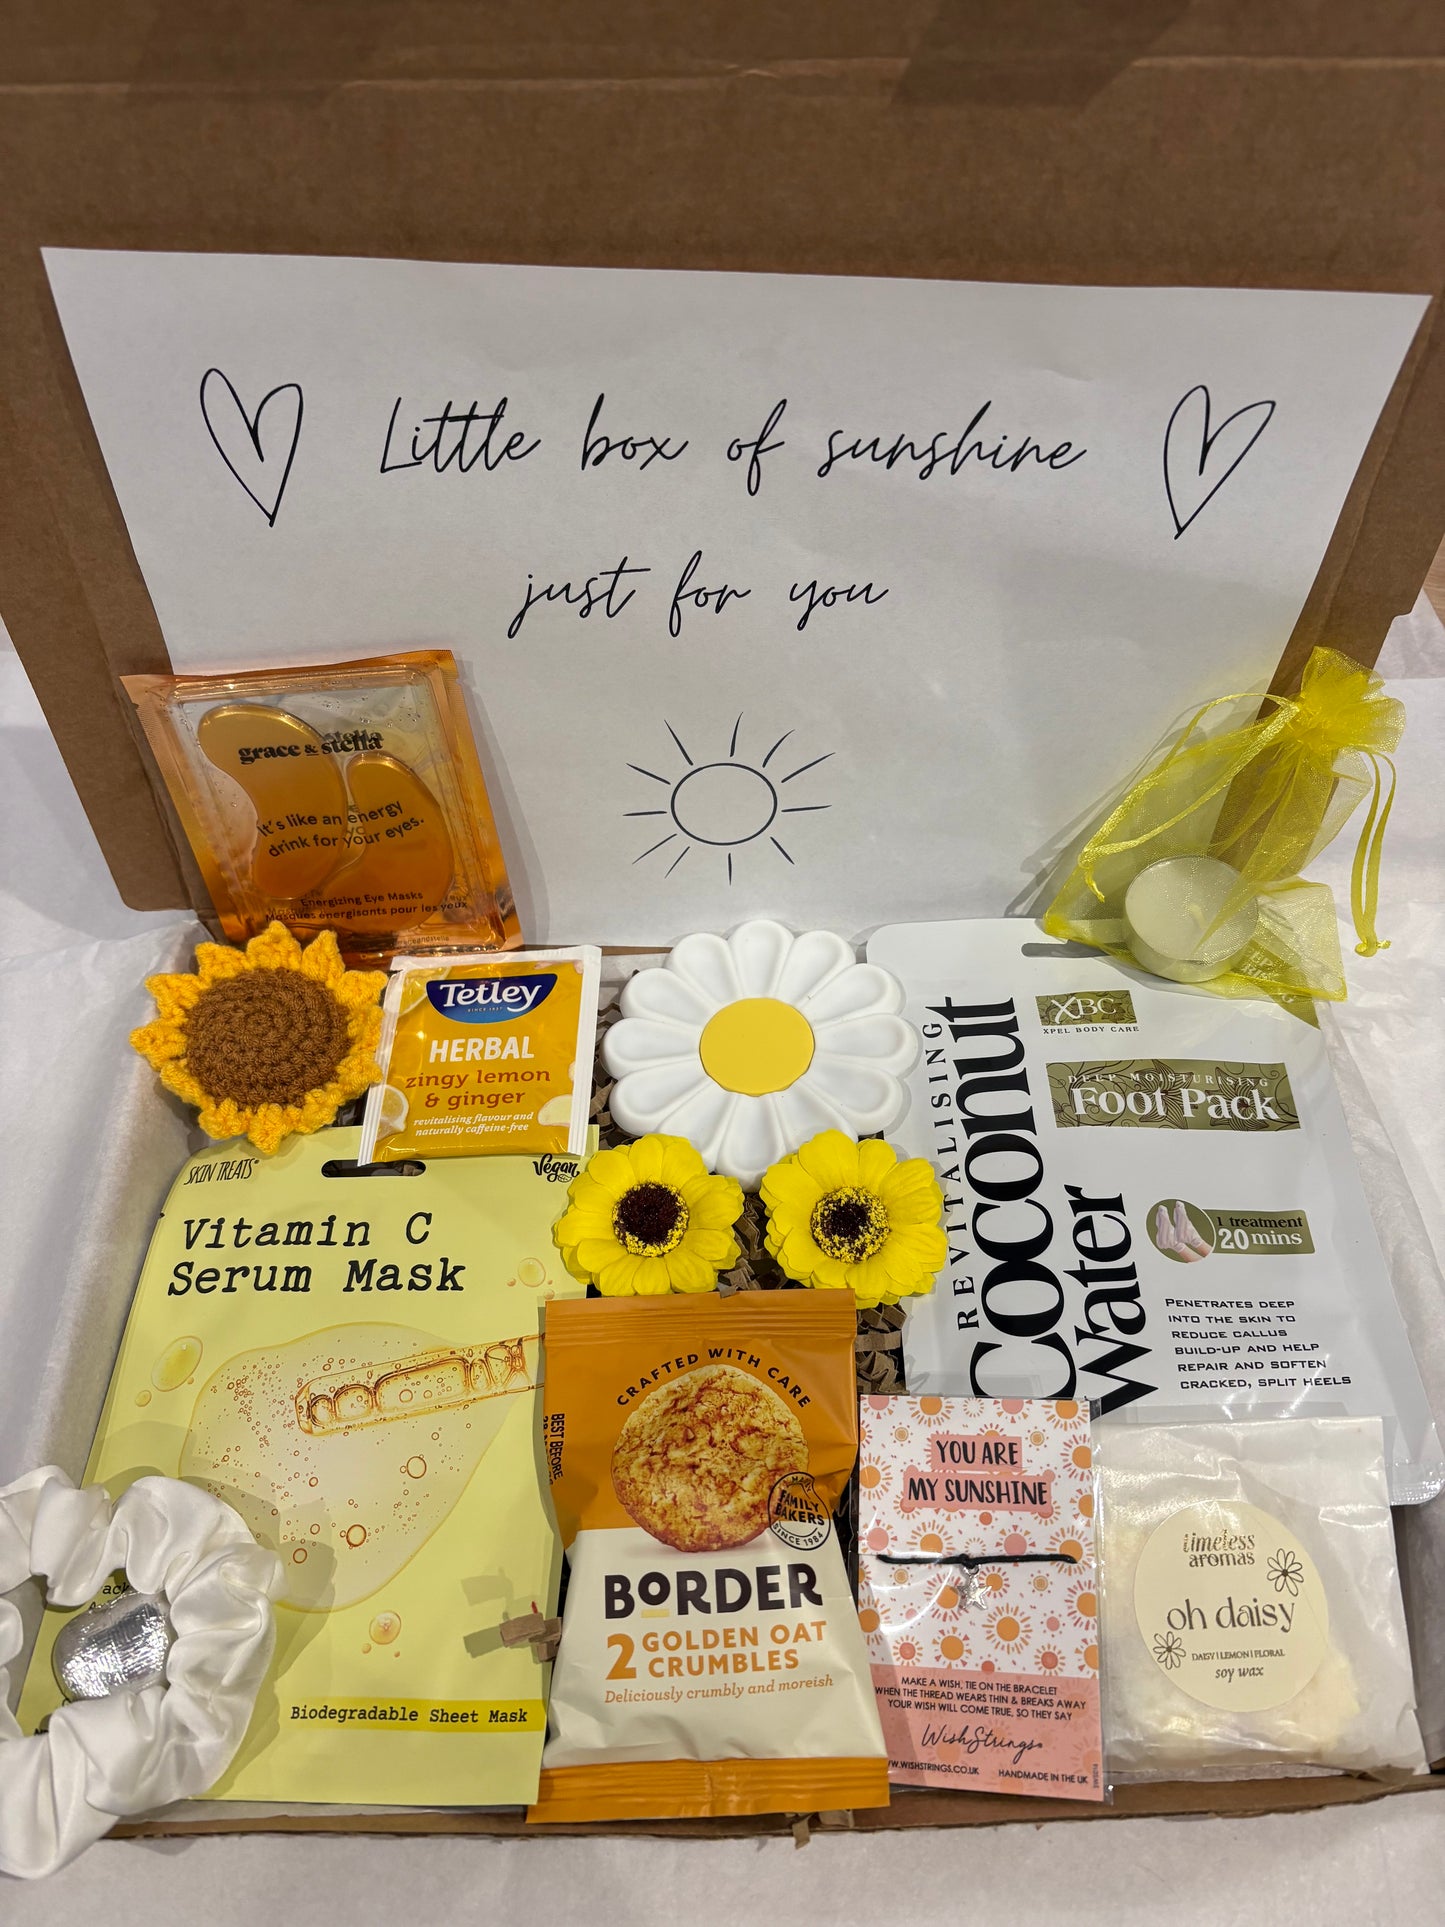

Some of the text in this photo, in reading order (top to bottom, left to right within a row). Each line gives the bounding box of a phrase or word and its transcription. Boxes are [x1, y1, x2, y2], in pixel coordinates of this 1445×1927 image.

[381, 393, 1087, 495] Little box of sunshine
[507, 550, 889, 638] just for you
[238, 731, 384, 765] grace & stella
[257, 800, 404, 837] It's like an energy
[268, 815, 425, 857] drink for your eyes.
[300, 892, 423, 908] Energizing Eye Masks
[390, 905, 418, 916] pour
[421, 903, 439, 913] les
[441, 901, 468, 912] yeux
[439, 981, 542, 1013] Tetley
[1050, 996, 1118, 1024] XBC
[1075, 1026, 1105, 1034] BODY
[429, 1036, 535, 1063] HERBAL
[405, 1069, 551, 1090] zingy lemon
[425, 1091, 526, 1110] & ginger
[1070, 1087, 1281, 1122] Foot Pack
[413, 1112, 534, 1126] revitalising flavour and
[415, 1122, 529, 1136] naturally caffeine-free
[183, 1159, 214, 1185] SKIN
[532, 1153, 580, 1183] Vegan
[922, 1022, 980, 1331] REVITALISING
[925, 996, 1077, 1400] Coconut
[183, 1212, 433, 1250] Vitamin C
[1229, 1216, 1303, 1228] treatment
[168, 1257, 466, 1296] Serum Mask
[1165, 1298, 1295, 1309] PENETRATES DEEP
[1168, 1315, 1296, 1324] INTO THE SKIN TO
[1171, 1329, 1288, 1339] REDUCE CALLUS
[1174, 1343, 1320, 1355] BUILD-UP AND HELP
[1177, 1360, 1327, 1372] REPAIR AND SOFTEN
[616, 1348, 811, 1409] CRAFTED WITH CARE
[1180, 1376, 1352, 1390] CRACKED, SPLIT HEELS
[549, 1413, 565, 1480] BEST BEFORE
[936, 1440, 1019, 1466] YOU ARE
[778, 1489, 819, 1512] FAMILY
[908, 1477, 1048, 1506] MY SUNSHINE
[775, 1502, 825, 1526] BAKERS
[772, 1522, 823, 1546] SINCE 1984
[1183, 1529, 1256, 1553] timeless
[1188, 1552, 1256, 1568] aromas
[604, 1563, 824, 1620] BORDER
[1166, 1596, 1295, 1633] oh daisy
[641, 1620, 827, 1653] GOLDEN OAT
[605, 1633, 637, 1680] 2
[647, 1648, 800, 1678] CRUMBLES
[1191, 1652, 1215, 1661] DAISY
[1220, 1650, 1250, 1660] LEMON
[1254, 1649, 1285, 1658] FLORAL
[901, 1676, 1057, 1696] MAKE A WISH, TIE ON THE BRACELET
[1215, 1666, 1264, 1683] soy wax
[604, 1674, 834, 1704] Deliciously crumbly and moreish
[875, 1686, 1086, 1710] WHEN THE THREAD WEARS THIN & BREAKS AWAY
[291, 1704, 528, 1724] Biodegradable Sheet Mask
[888, 1698, 1072, 1721] YOUR WISH WILL COME TRUE, SO THEY SAY
[998, 1768, 1049, 1782] HANDMADE
[1051, 1772, 1059, 1782] IN
[1061, 1773, 1076, 1784] THE
[1077, 1775, 1089, 1785] UK
